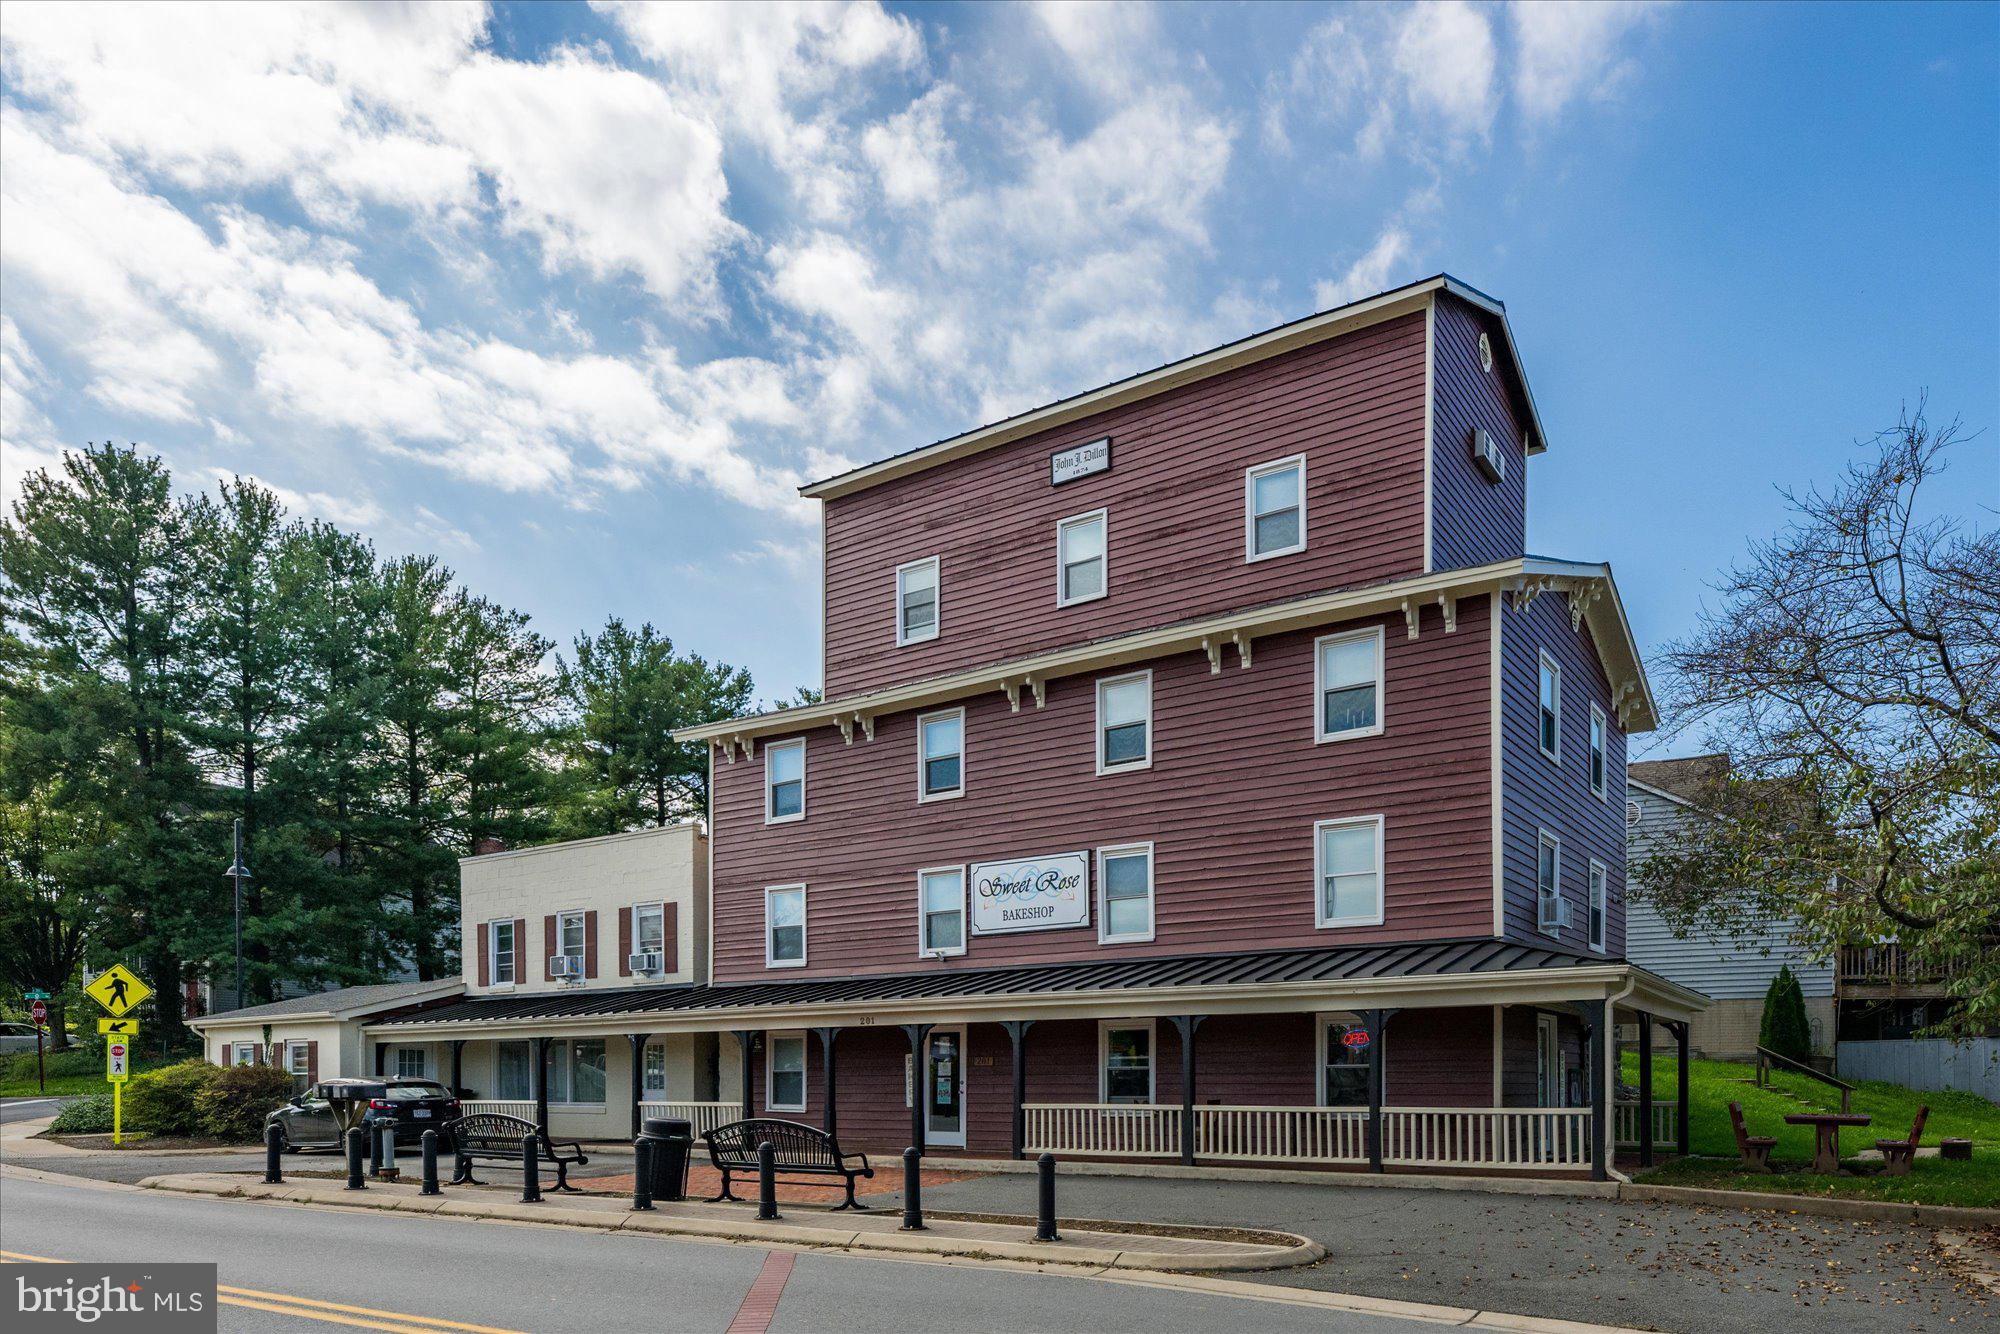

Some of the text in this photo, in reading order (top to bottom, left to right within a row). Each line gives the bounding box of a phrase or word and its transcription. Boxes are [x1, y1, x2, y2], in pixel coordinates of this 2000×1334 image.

[1054, 457, 1073, 473] John
[1083, 447, 1107, 462] Dillon
[979, 870, 1080, 897] Sweet Rose
[1002, 905, 1055, 922] BAKESHOP
[33, 1008, 46, 1018] STOP
[859, 1016, 875, 1025] 201
[1343, 1031, 1370, 1046] OPEN
